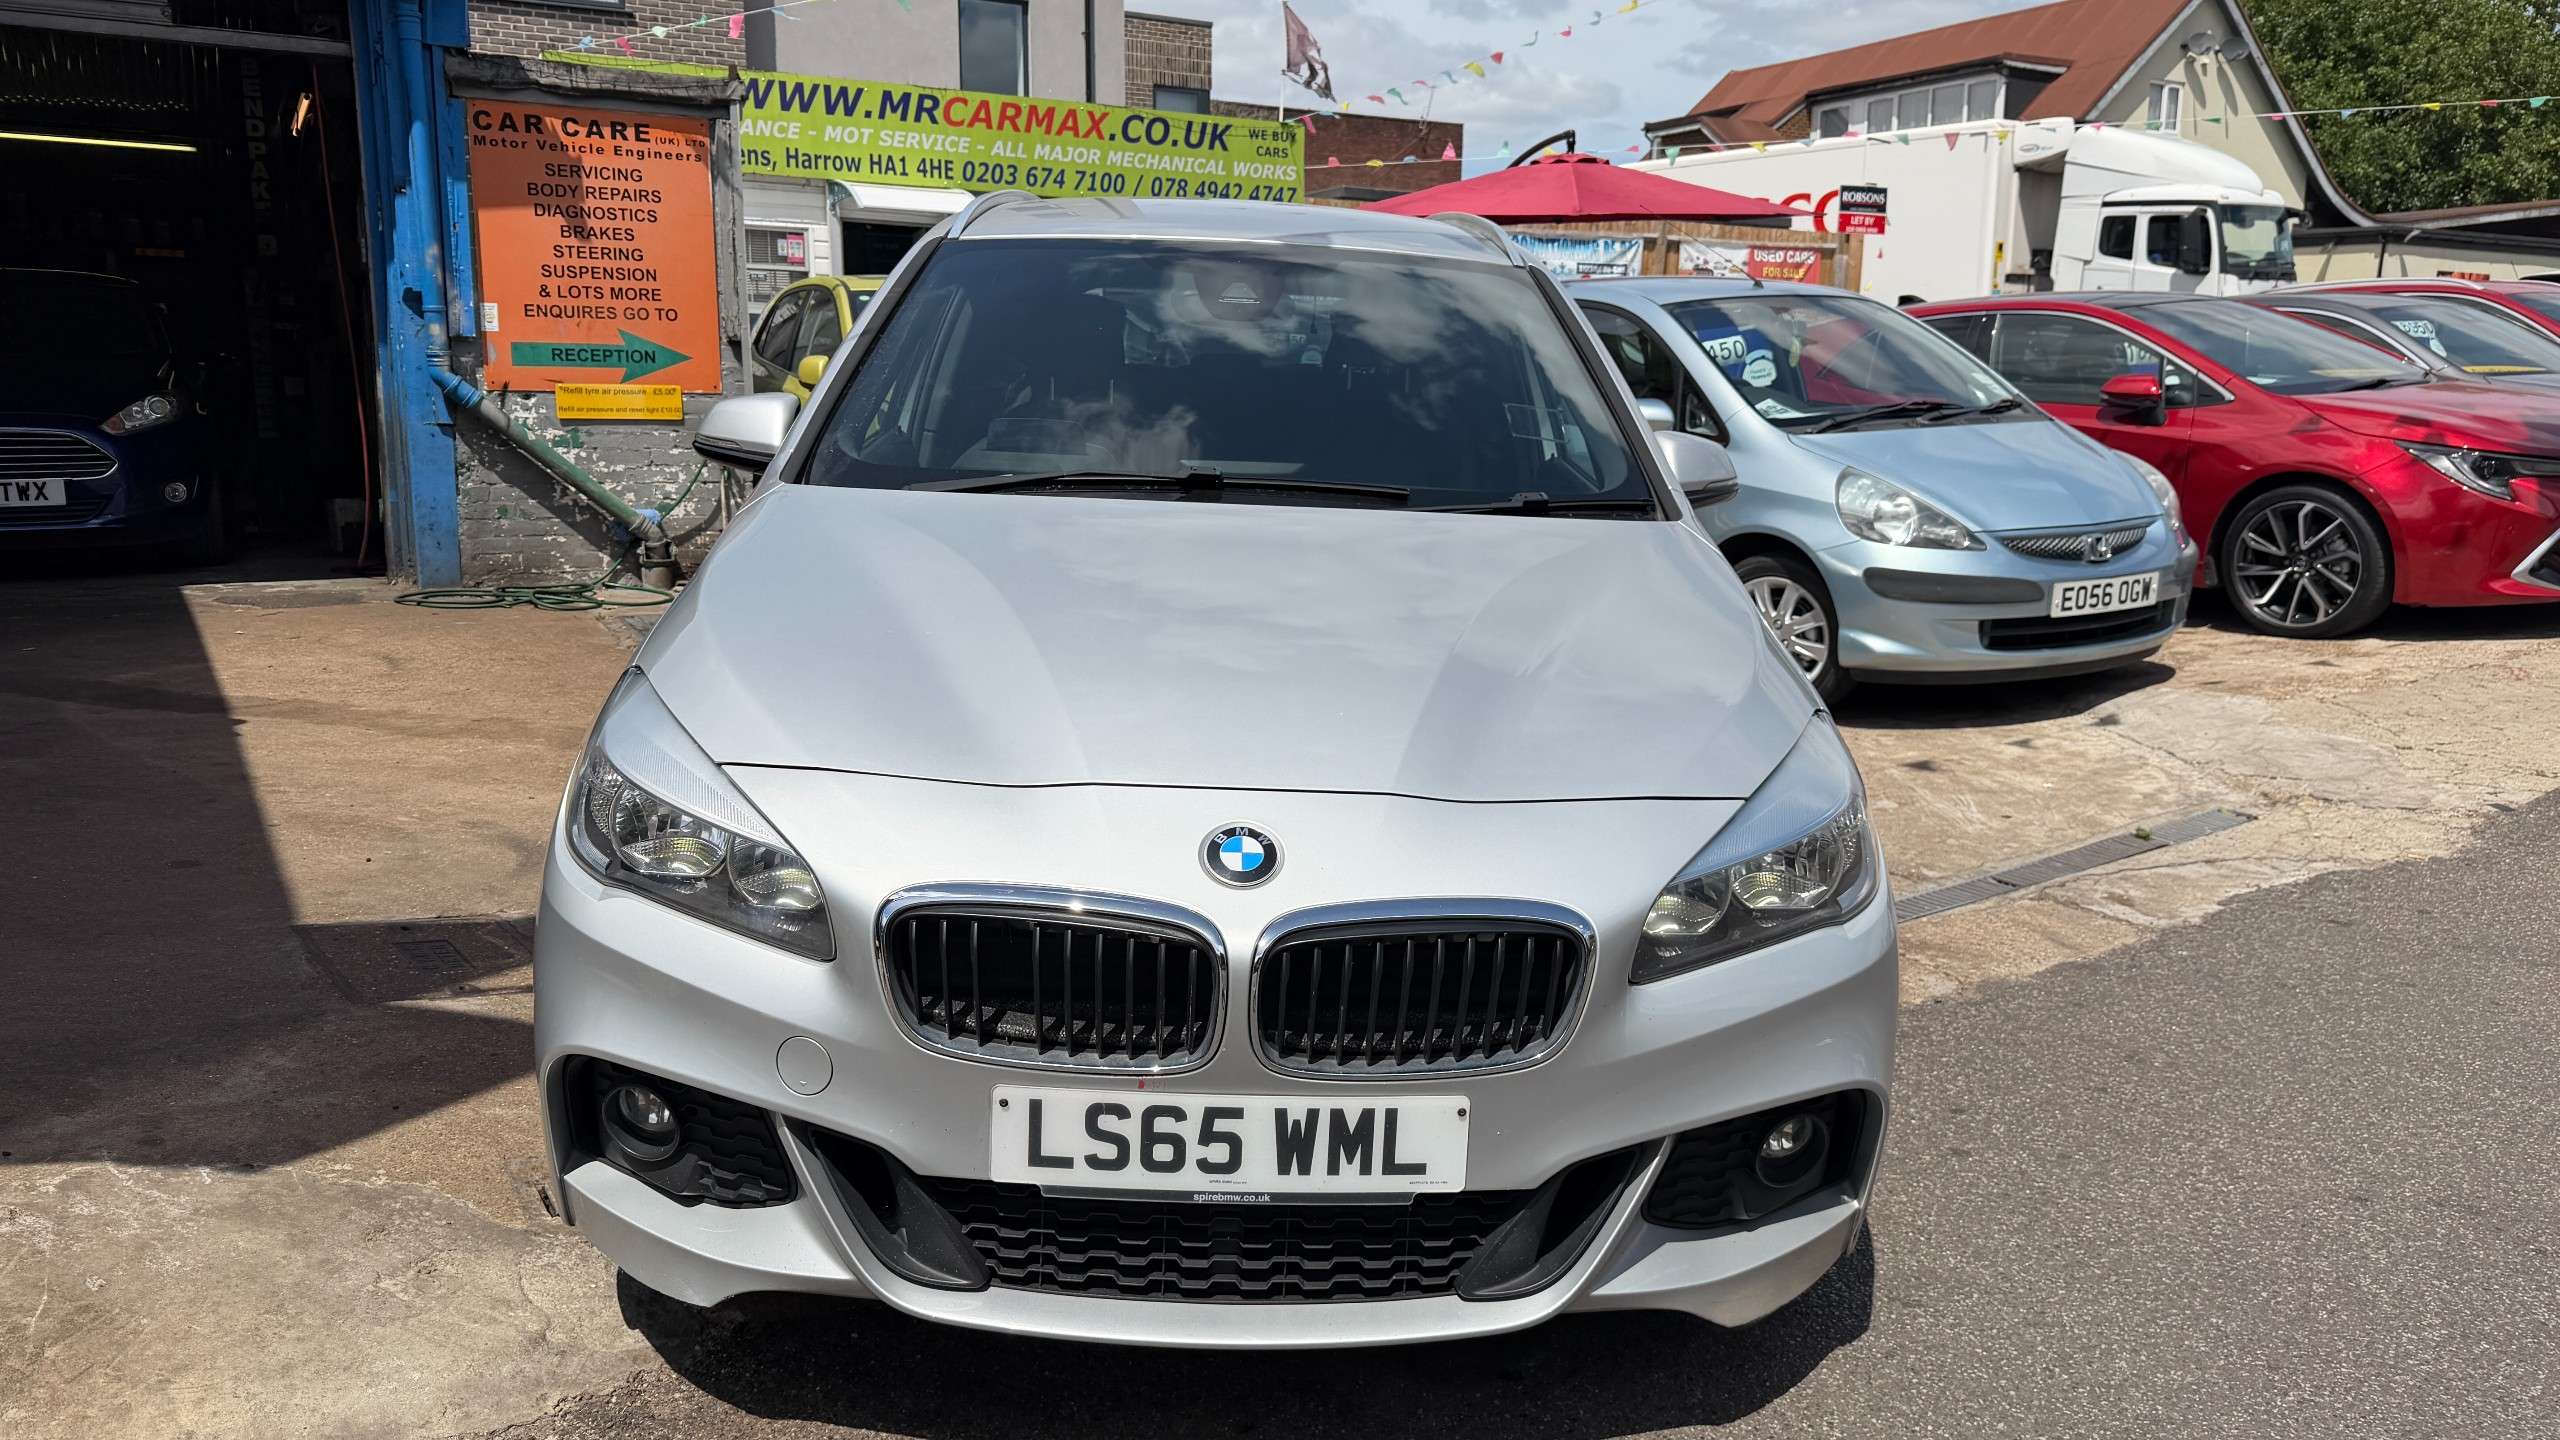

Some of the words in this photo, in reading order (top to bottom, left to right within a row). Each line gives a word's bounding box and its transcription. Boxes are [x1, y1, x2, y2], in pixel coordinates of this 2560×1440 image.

[472, 110, 543, 134] CAR
[561, 117, 651, 143] CARE
[655, 137, 680, 147] (UK)
[685, 139, 705, 148] LTD
[1249, 128, 1268, 141] WE
[1272, 129, 1297, 143] BUY
[473, 135, 528, 149] Motor
[536, 139, 605, 155] Vehicle
[613, 145, 702, 163] Engineers
[824, 126, 873, 145] MOT
[879, 129, 970, 153] SERVICE
[991, 141, 1027, 159] ALL
[1034, 145, 1101, 166] MAJOR
[1107, 151, 1226, 175] MECHANICAL
[1233, 161, 1297, 180] WORKS
[1256, 146, 1289, 158] CARS
[544, 162, 643, 183] SERVICING
[786, 148, 862, 173] Harrow
[869, 154, 908, 176] HA1
[916, 158, 954, 180] 4HE
[962, 161, 1018, 185] 0203
[1026, 166, 1065, 189] 674
[1074, 170, 1125, 194] 7100
[1151, 177, 1188, 197] 078
[1195, 182, 1243, 199] 4942
[527, 183, 578, 199] BODY
[585, 186, 662, 203] REPAIRS
[1842, 191, 1885, 204] ROBSONS
[534, 203, 657, 223] DIAGNOSTICS
[560, 225, 635, 242] BRAKES
[553, 245, 644, 262] STEERING
[1754, 249, 1783, 262] USED
[1787, 250, 1817, 264] CARS
[541, 264, 657, 282] SUSPENSION
[1762, 266, 1780, 277] FOR
[1783, 268, 1806, 279] SALE
[539, 284, 551, 298] &
[557, 285, 604, 300] LOTS
[610, 287, 662, 302] MORE
[524, 304, 617, 320] ENQUIRES
[623, 307, 649, 321] GO
[655, 309, 678, 322] TO
[551, 348, 657, 364] RECEPTION
[1214, 827, 1272, 845] BMW
[1027, 1098, 1245, 1176] LS65
[1275, 1107, 1428, 1176] WML
[1193, 1192, 1271, 1203] spirebmw.co.uk
